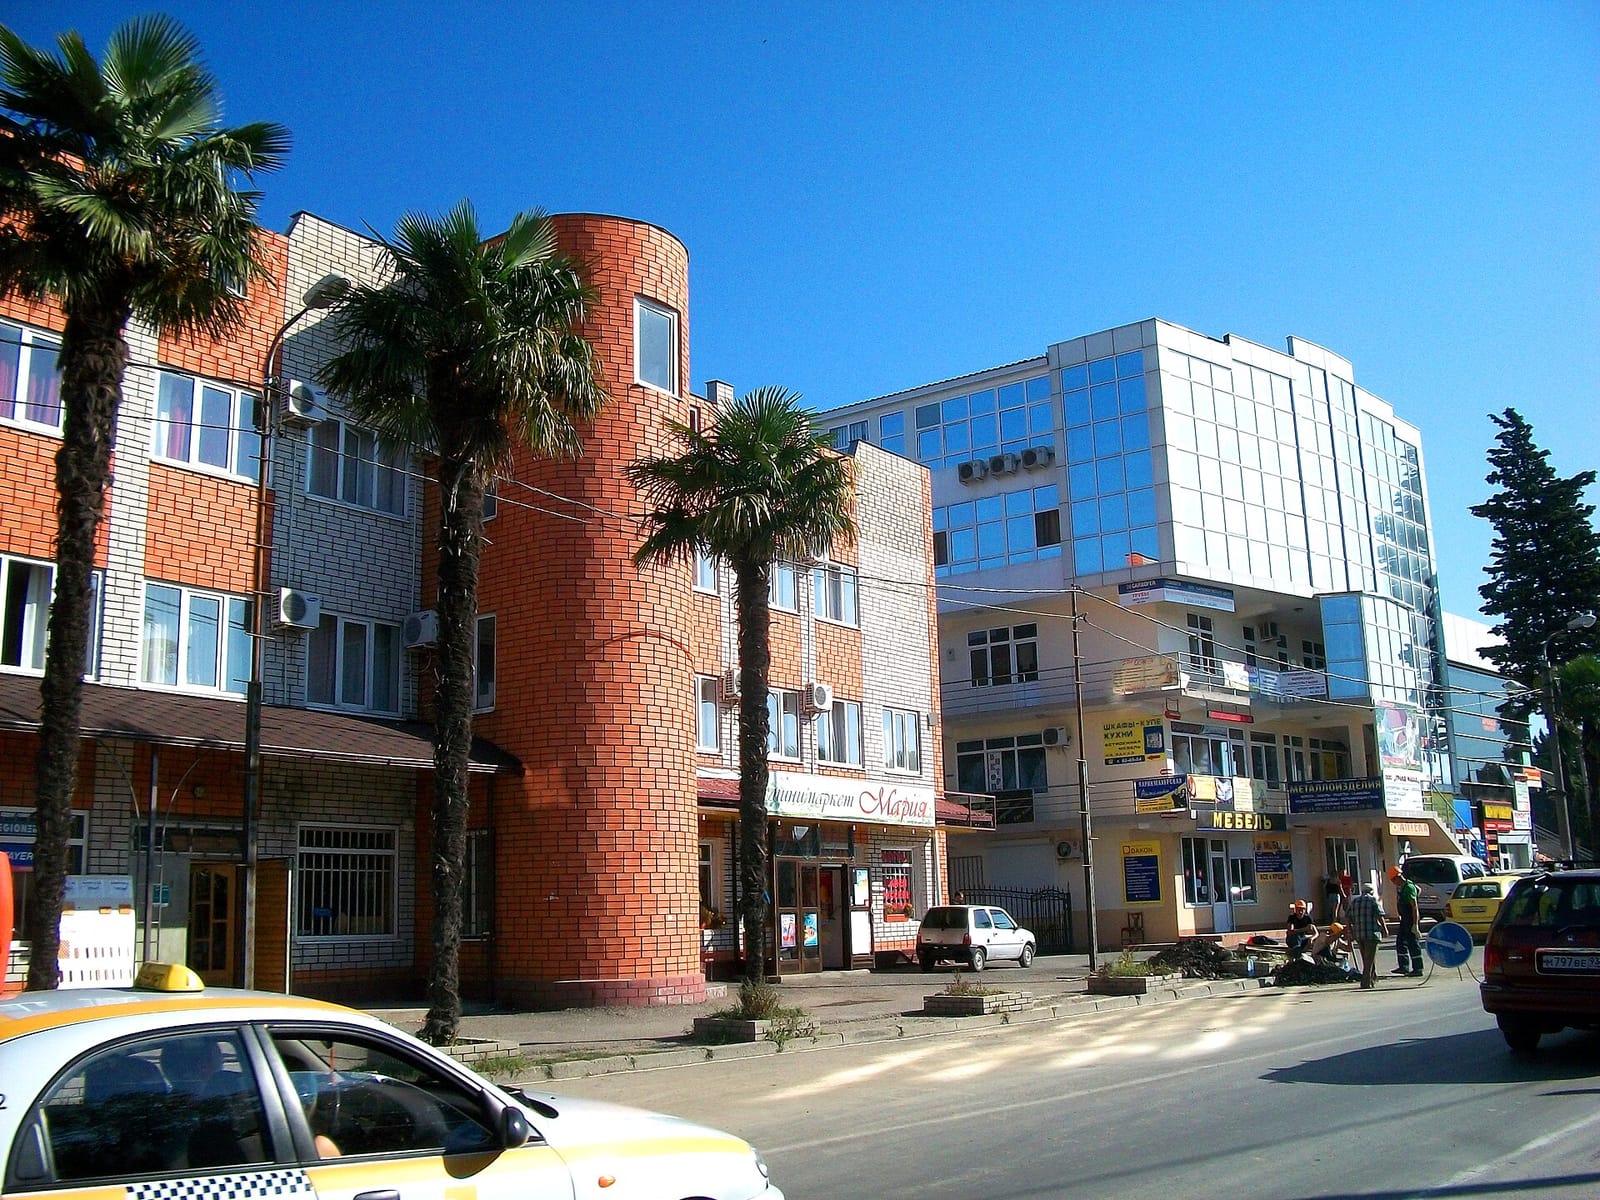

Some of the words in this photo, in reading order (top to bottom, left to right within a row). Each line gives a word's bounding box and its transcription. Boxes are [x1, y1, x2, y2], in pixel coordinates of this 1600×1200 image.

[1104, 718, 1161, 730] ШКАФЫ-КУПЕ
[1104, 730, 1133, 739] КУХНИ
[1289, 780, 1381, 793] МЕТАЛЛОИЗДЕЛИЯ
[858, 786, 929, 822] Мария
[1213, 811, 1272, 830] МЕБЕЛЬ
[6, 851, 34, 861] AYER
